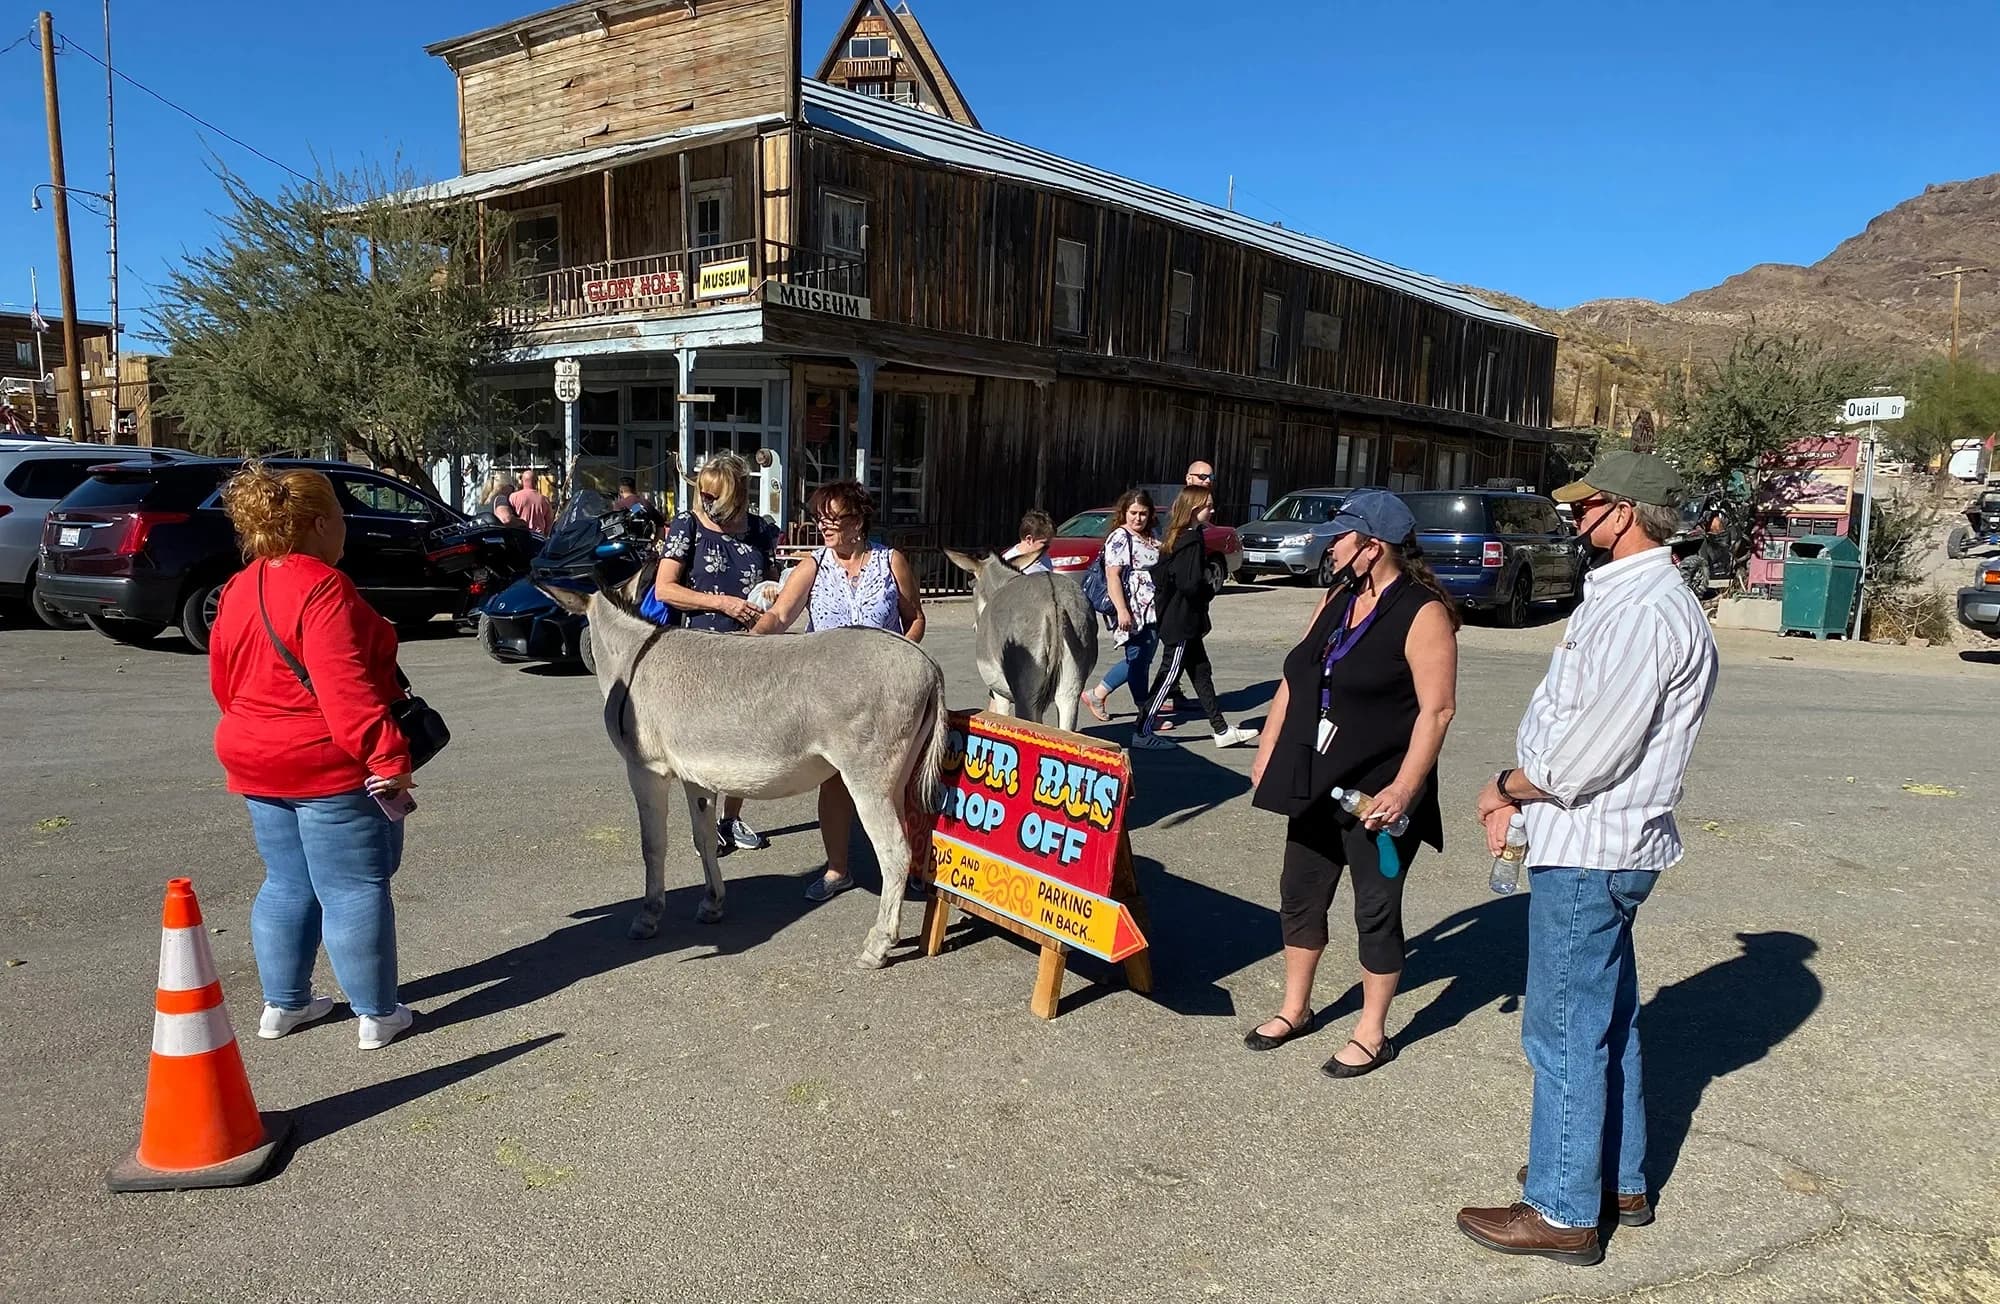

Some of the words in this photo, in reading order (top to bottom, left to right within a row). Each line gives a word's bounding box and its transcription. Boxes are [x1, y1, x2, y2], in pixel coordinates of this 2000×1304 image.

[587, 276, 635, 302] GLORY
[640, 272, 680, 296] HOLE
[703, 269, 746, 290] MUSEUM
[780, 285, 860, 317] MUSEUM
[562, 364, 572, 374] US
[560, 379, 576, 398] 66
[1848, 402, 1879, 417] Quail
[1891, 404, 1901, 415] Dr
[941, 730, 1019, 795] OUR
[1034, 756, 1119, 828] BUS
[1021, 812, 1088, 863] OFF
[960, 856, 979, 872] AND
[1038, 881, 1092, 919] PARKING
[1040, 908, 1054, 925] IN
